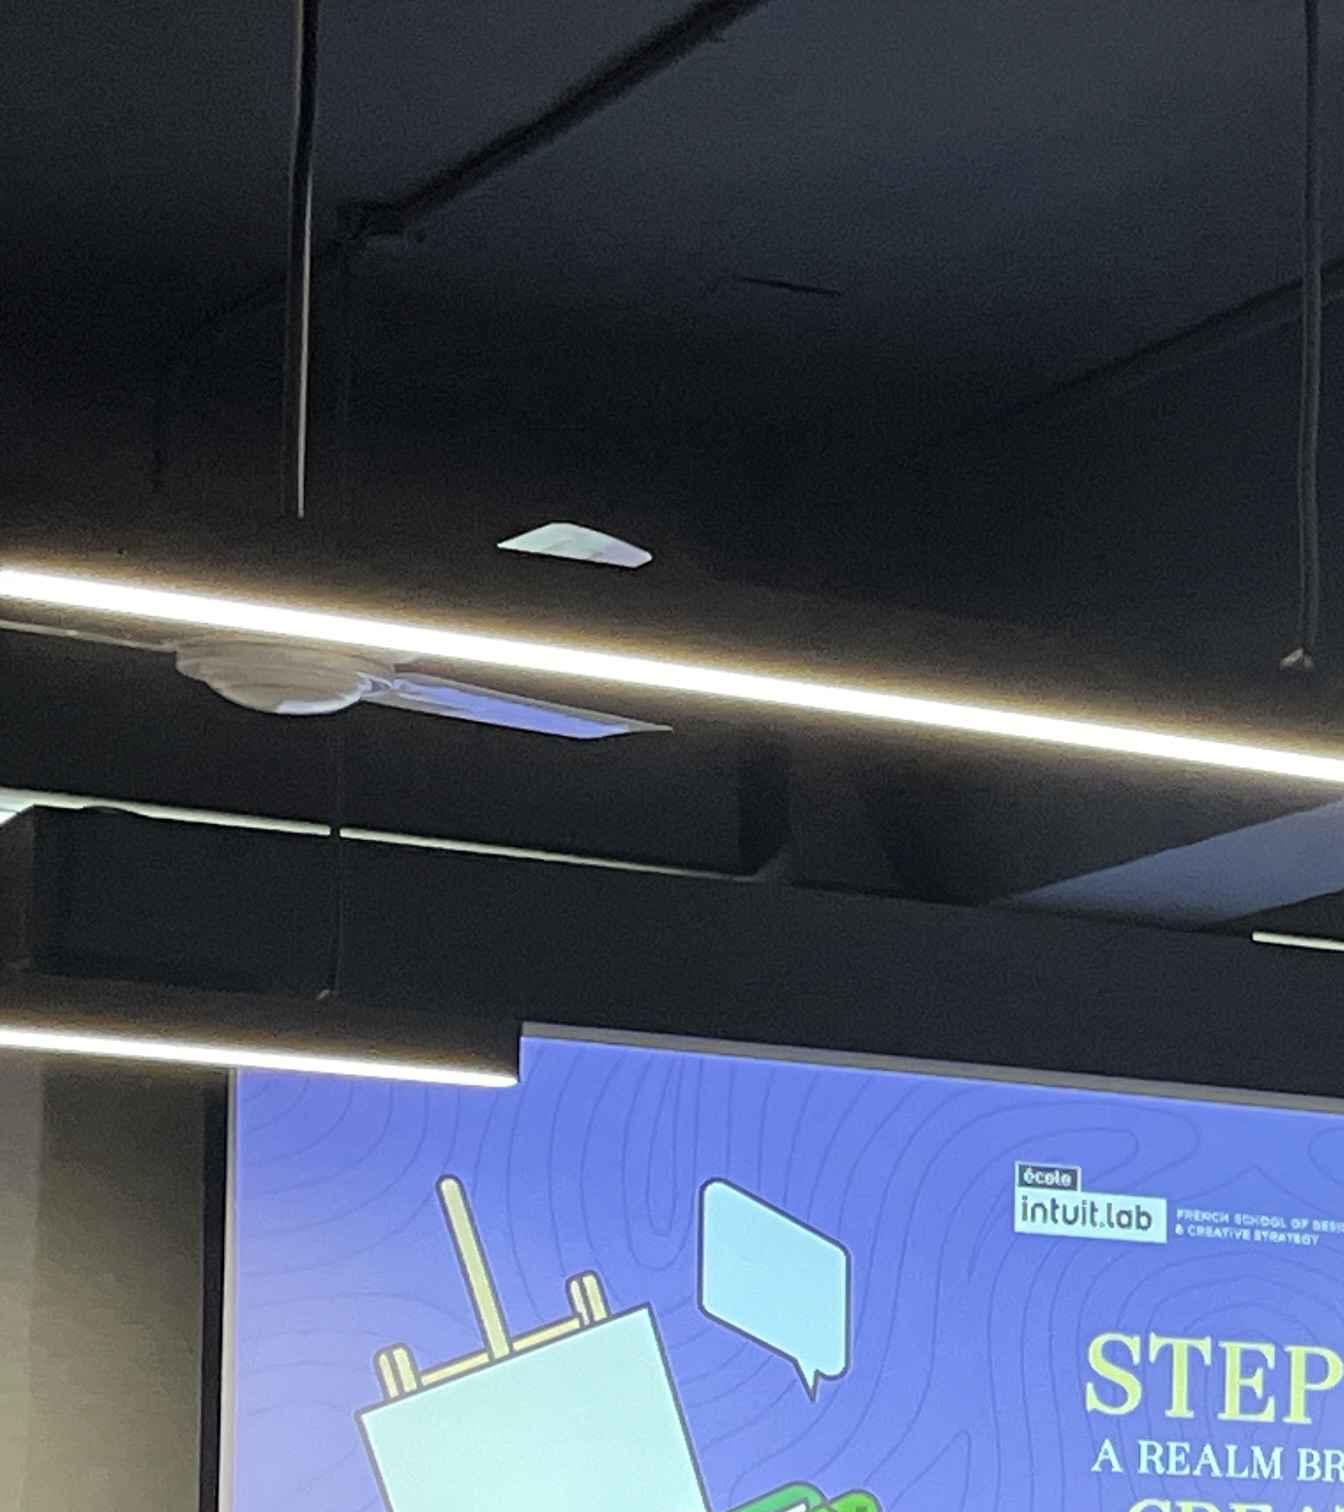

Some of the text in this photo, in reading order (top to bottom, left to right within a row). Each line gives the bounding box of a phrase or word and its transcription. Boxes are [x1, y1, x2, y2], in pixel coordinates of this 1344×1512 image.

[1021, 1195, 1153, 1231] intuit.lab
[1086, 1332, 1344, 1425] STEP
[1091, 1438, 1123, 1473] A
[1137, 1439, 1284, 1480] REALM
